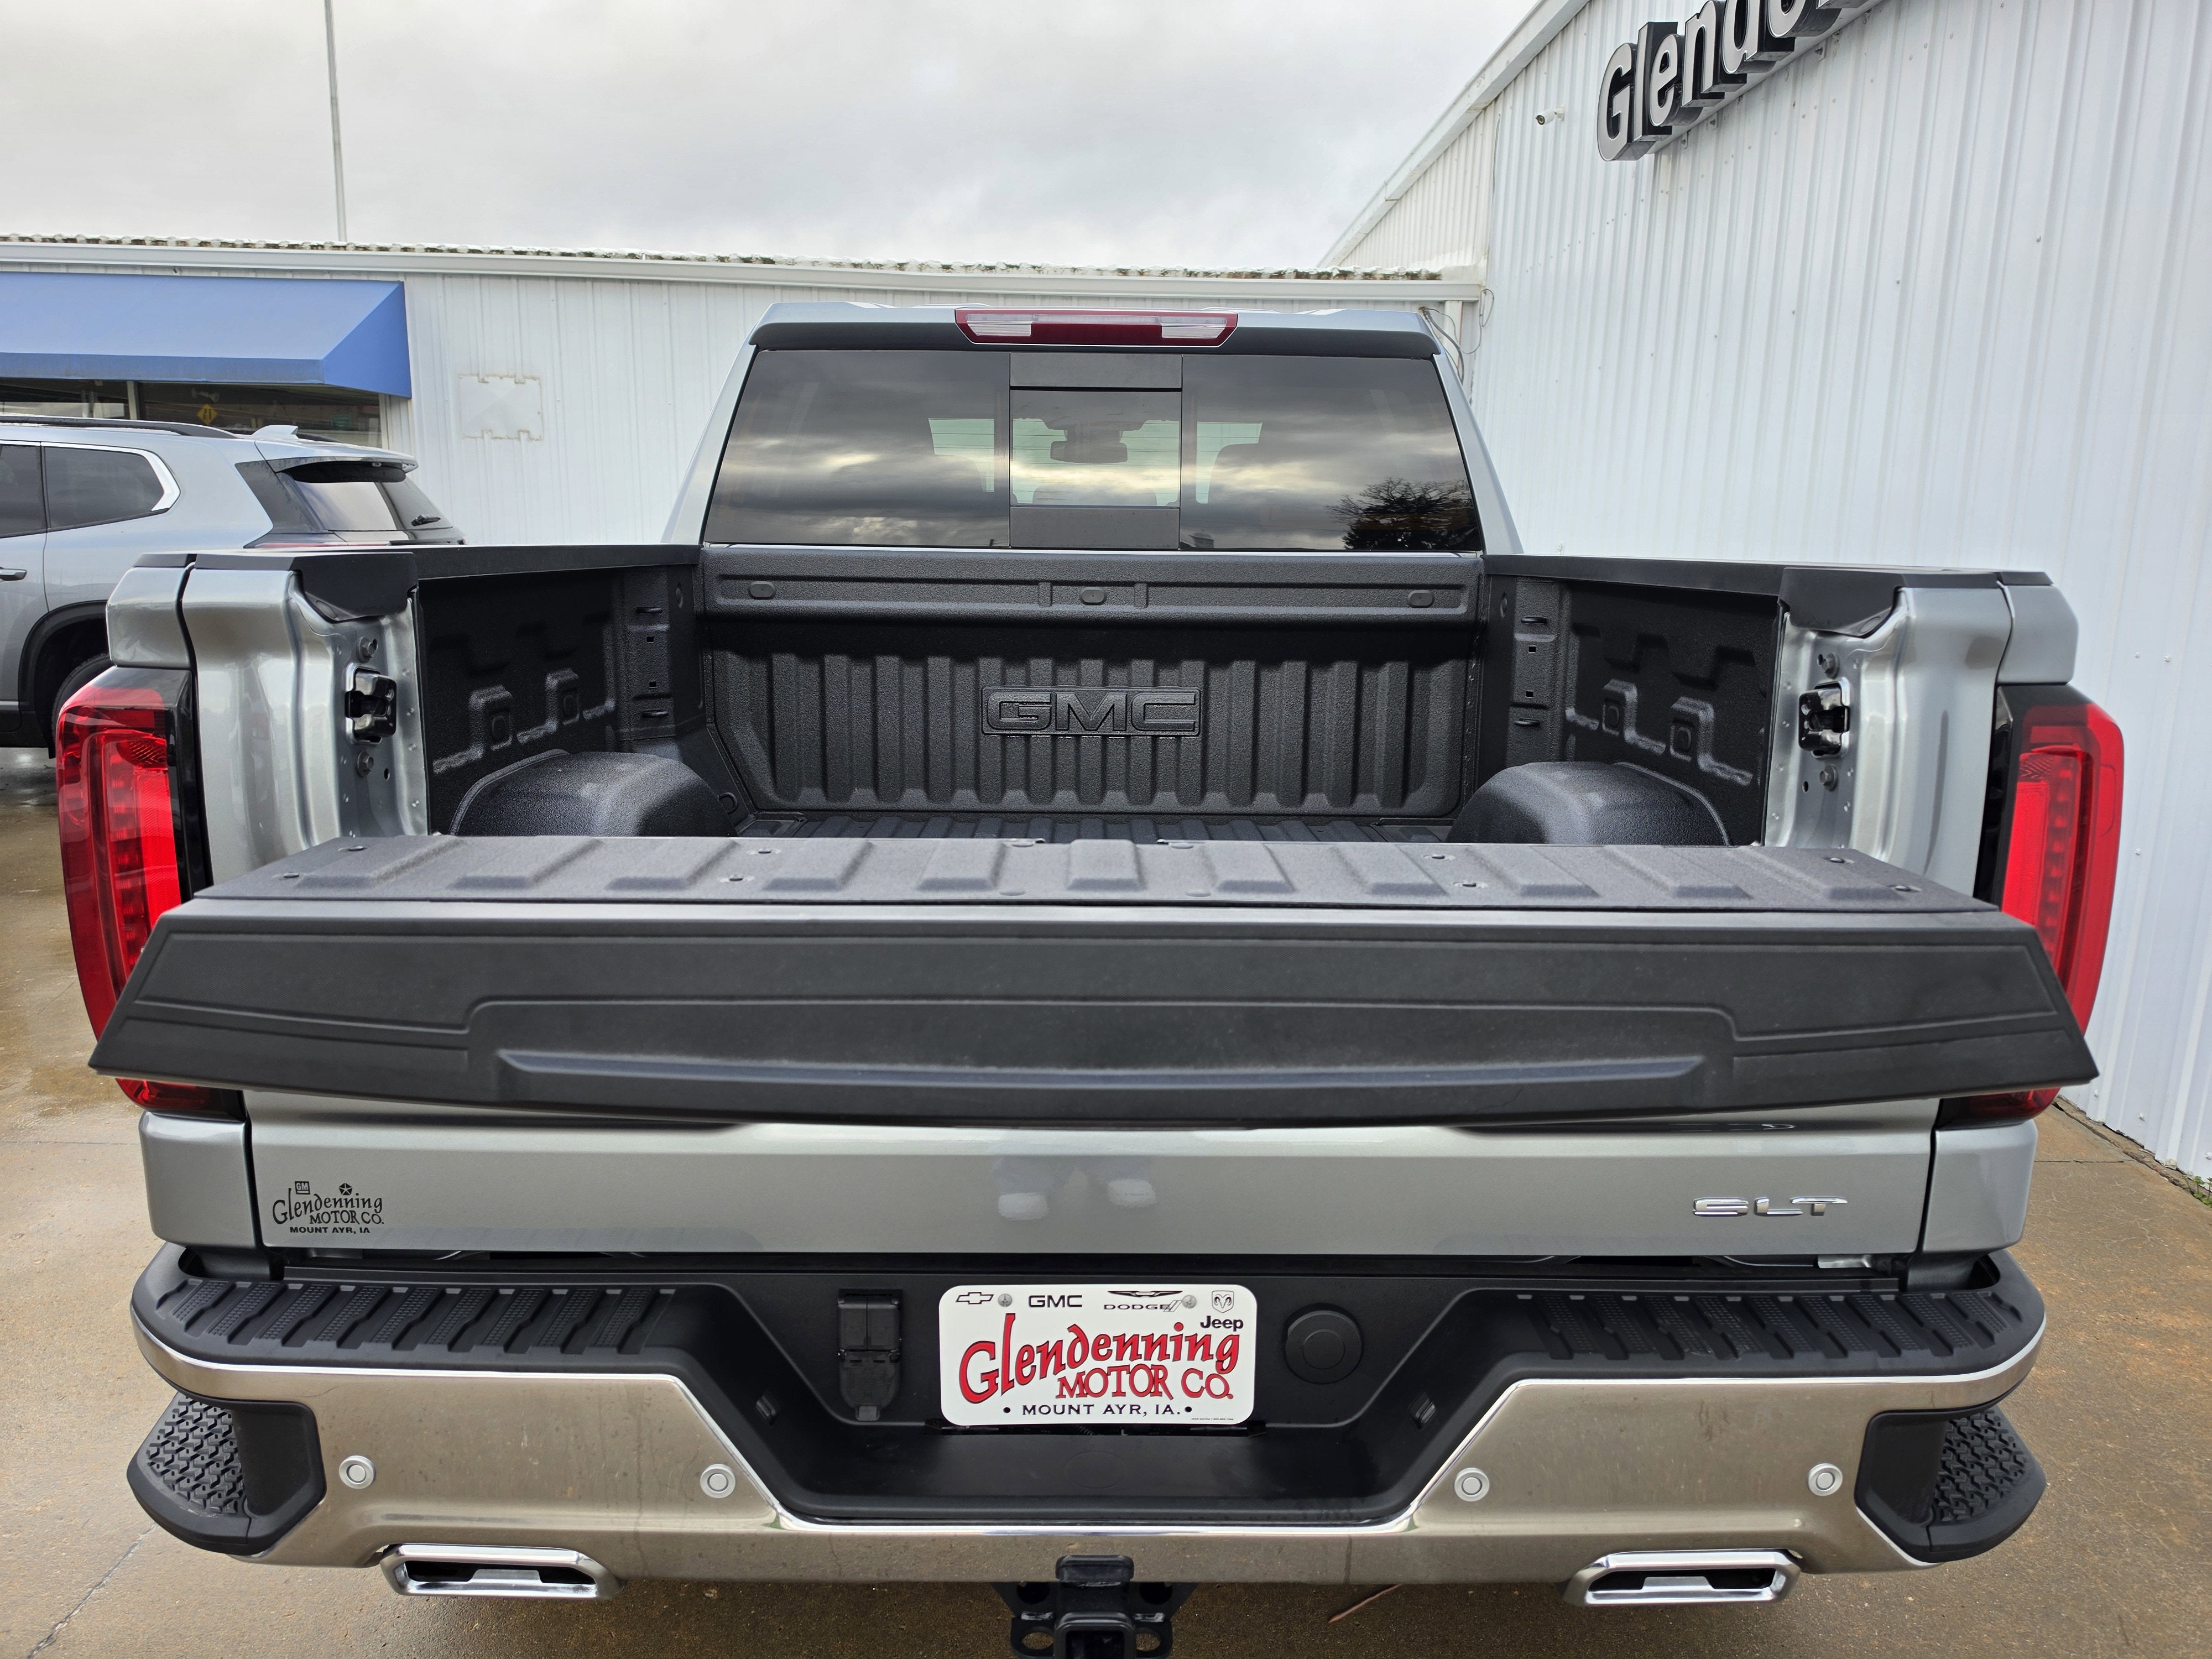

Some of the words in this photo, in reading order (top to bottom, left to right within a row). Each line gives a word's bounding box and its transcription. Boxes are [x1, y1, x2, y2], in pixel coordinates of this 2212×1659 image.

[1597, 0, 1844, 161] Glend
[987, 691, 1197, 732] GMC
[272, 1187, 383, 1225] Glendenning
[309, 1209, 360, 1224] MOTOR
[361, 1211, 384, 1224] CO.
[1692, 1196, 1848, 1217] SLT
[1028, 1295, 1082, 1308] GMC
[1199, 1315, 1244, 1332] Jeep
[958, 1313, 1240, 1404] Glendenning
[1055, 1364, 1174, 1400] MOTOR
[1181, 1368, 1234, 1400] CO.
[1022, 1404, 1094, 1416] MOUNT
[1102, 1404, 1148, 1417] AYR,
